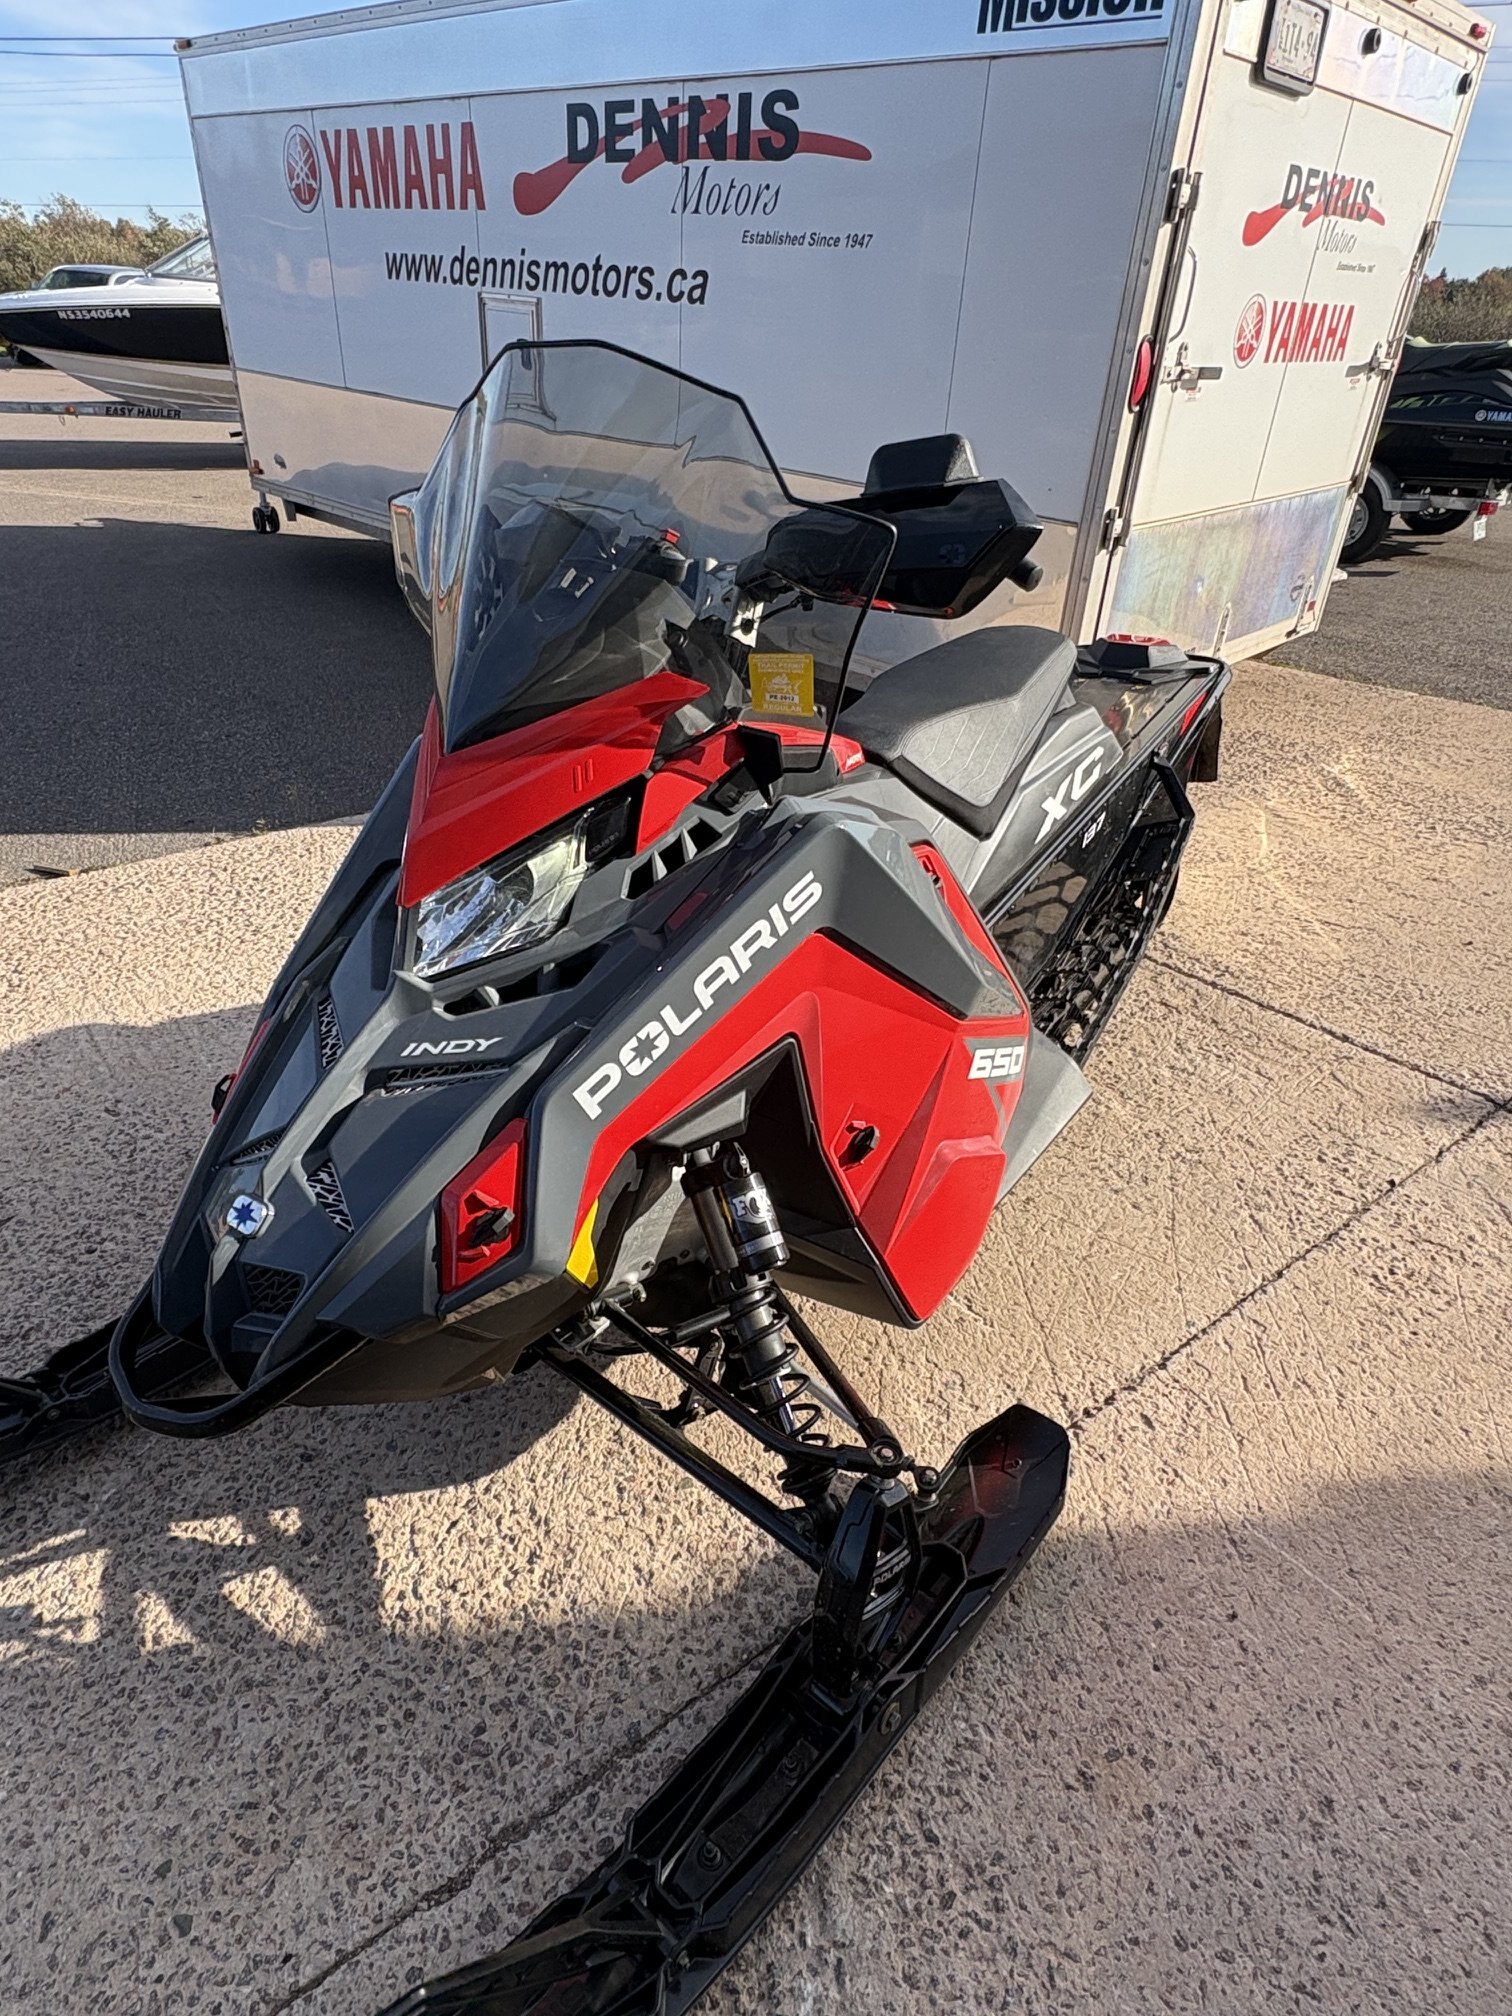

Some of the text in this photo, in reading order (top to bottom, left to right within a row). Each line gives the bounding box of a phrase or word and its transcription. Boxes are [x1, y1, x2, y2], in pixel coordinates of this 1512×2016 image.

[566, 89, 800, 163] DENNIS
[319, 121, 486, 210] YAMAHA
[670, 166, 783, 216] Motors
[1280, 163, 1375, 222] DENNIS
[741, 230, 874, 248] Established Since 1947
[385, 245, 710, 306] www.dennismotors.ca
[57, 309, 131, 320] NS3540644
[1263, 300, 1355, 364] YAMAHA
[105, 406, 182, 419] EASY HAULER
[1034, 746, 1105, 845] XC
[572, 870, 823, 1121] POLARIS
[400, 1036, 504, 1057] INDY
[967, 1045, 1025, 1080] 650
